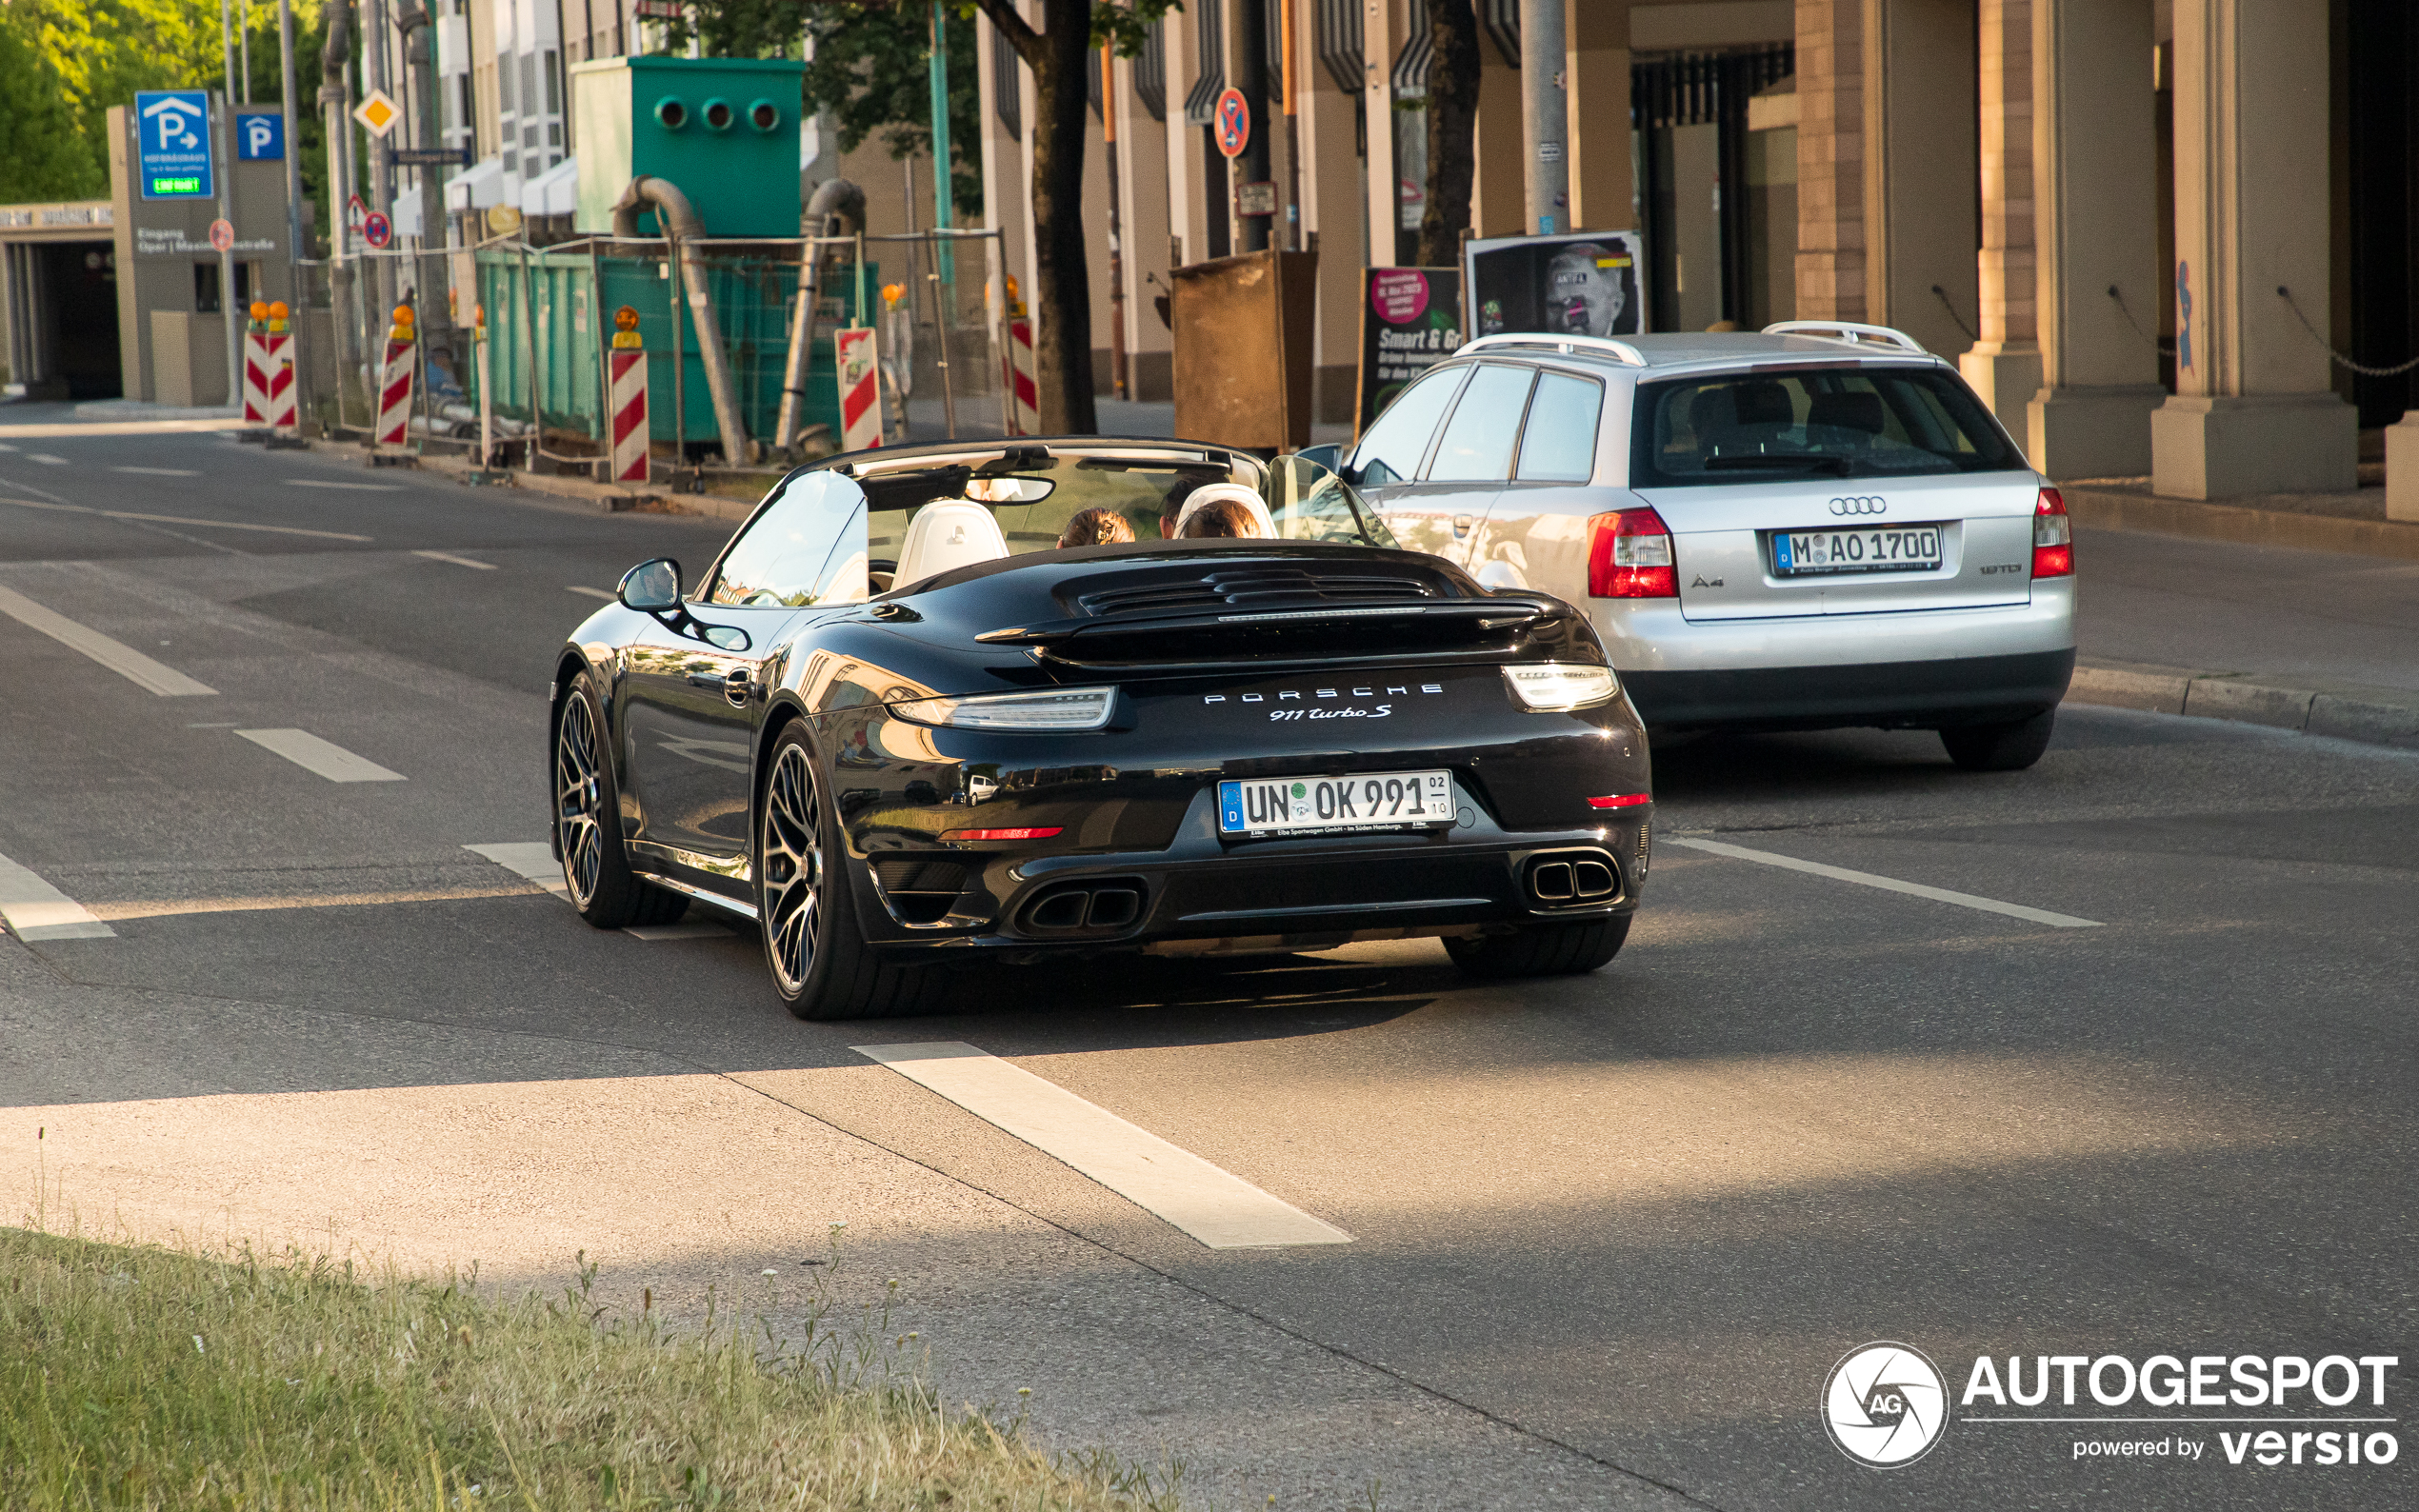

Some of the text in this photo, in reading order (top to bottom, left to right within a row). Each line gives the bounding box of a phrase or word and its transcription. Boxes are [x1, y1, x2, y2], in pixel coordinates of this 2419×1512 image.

[158, 112, 186, 150] P
[250, 126, 272, 157] P
[138, 228, 184, 241] Eingang
[1379, 328, 1427, 349] Smart
[1429, 328, 1440, 349] &
[1792, 531, 1937, 563] M AO 1700
[1781, 554, 1788, 563] D
[1691, 573, 1724, 587] A4
[1204, 684, 1444, 705] PORSCHE
[1269, 705, 1391, 721] 911 turbo S
[1429, 777, 1445, 787] 02
[1246, 778, 1426, 823] UN OK 991
[1432, 803, 1446, 813] 10
[1229, 811, 1238, 822] D
[1290, 827, 1324, 836] Sportwagen
